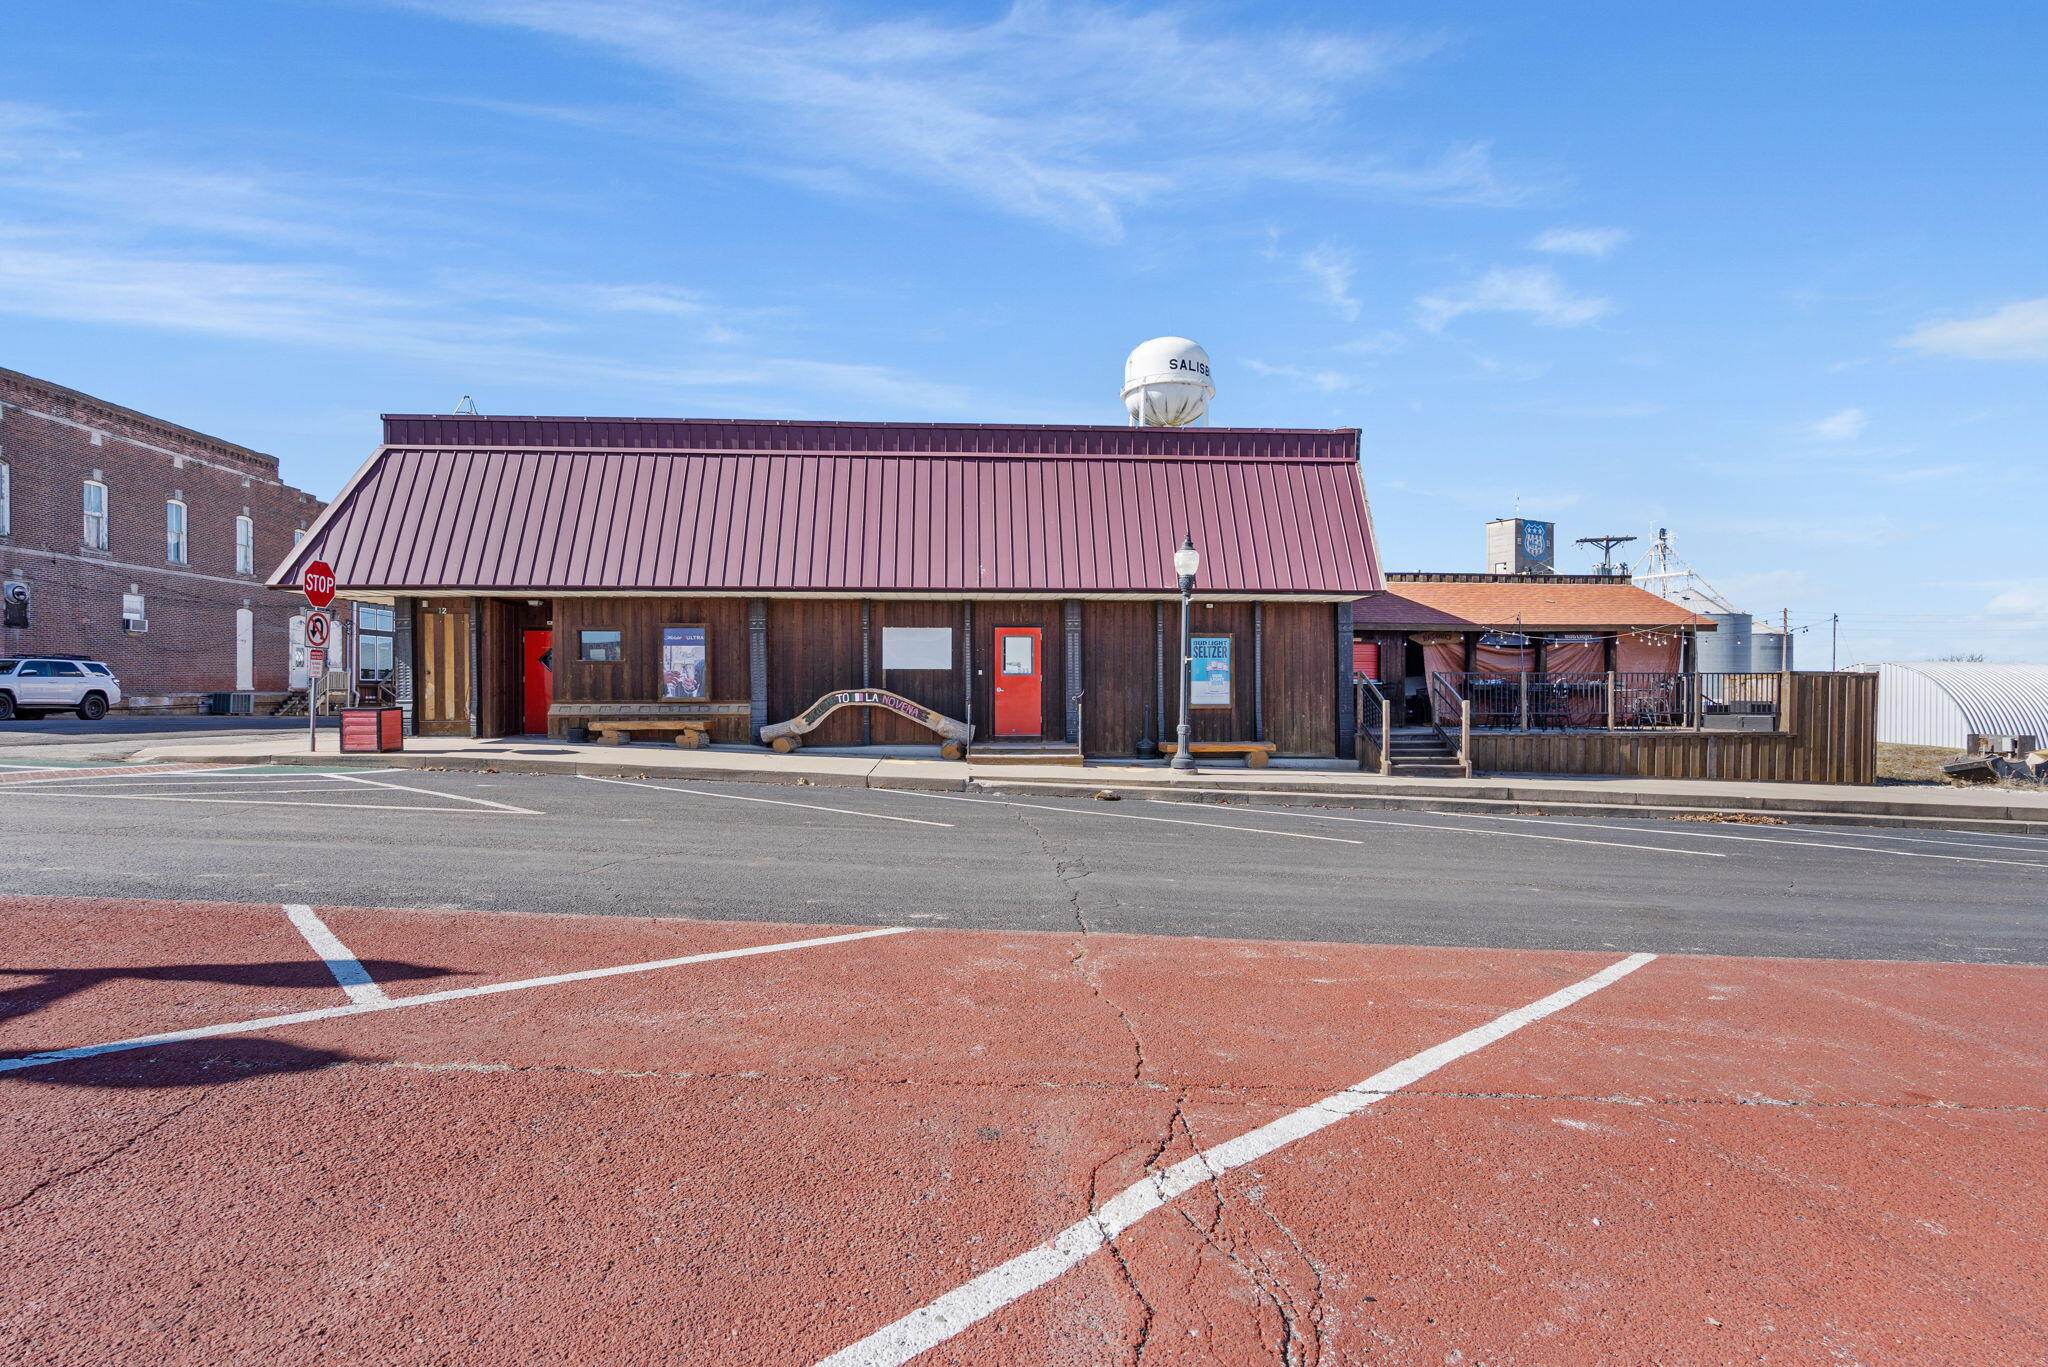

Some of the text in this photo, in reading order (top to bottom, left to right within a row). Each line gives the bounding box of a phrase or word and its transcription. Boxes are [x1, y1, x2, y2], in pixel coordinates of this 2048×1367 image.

[306, 573, 334, 594] STOP
[1193, 646, 1228, 658] SELTZER
[836, 692, 850, 703] TO
[865, 692, 879, 703] LA
[882, 695, 919, 718] NOVENA
